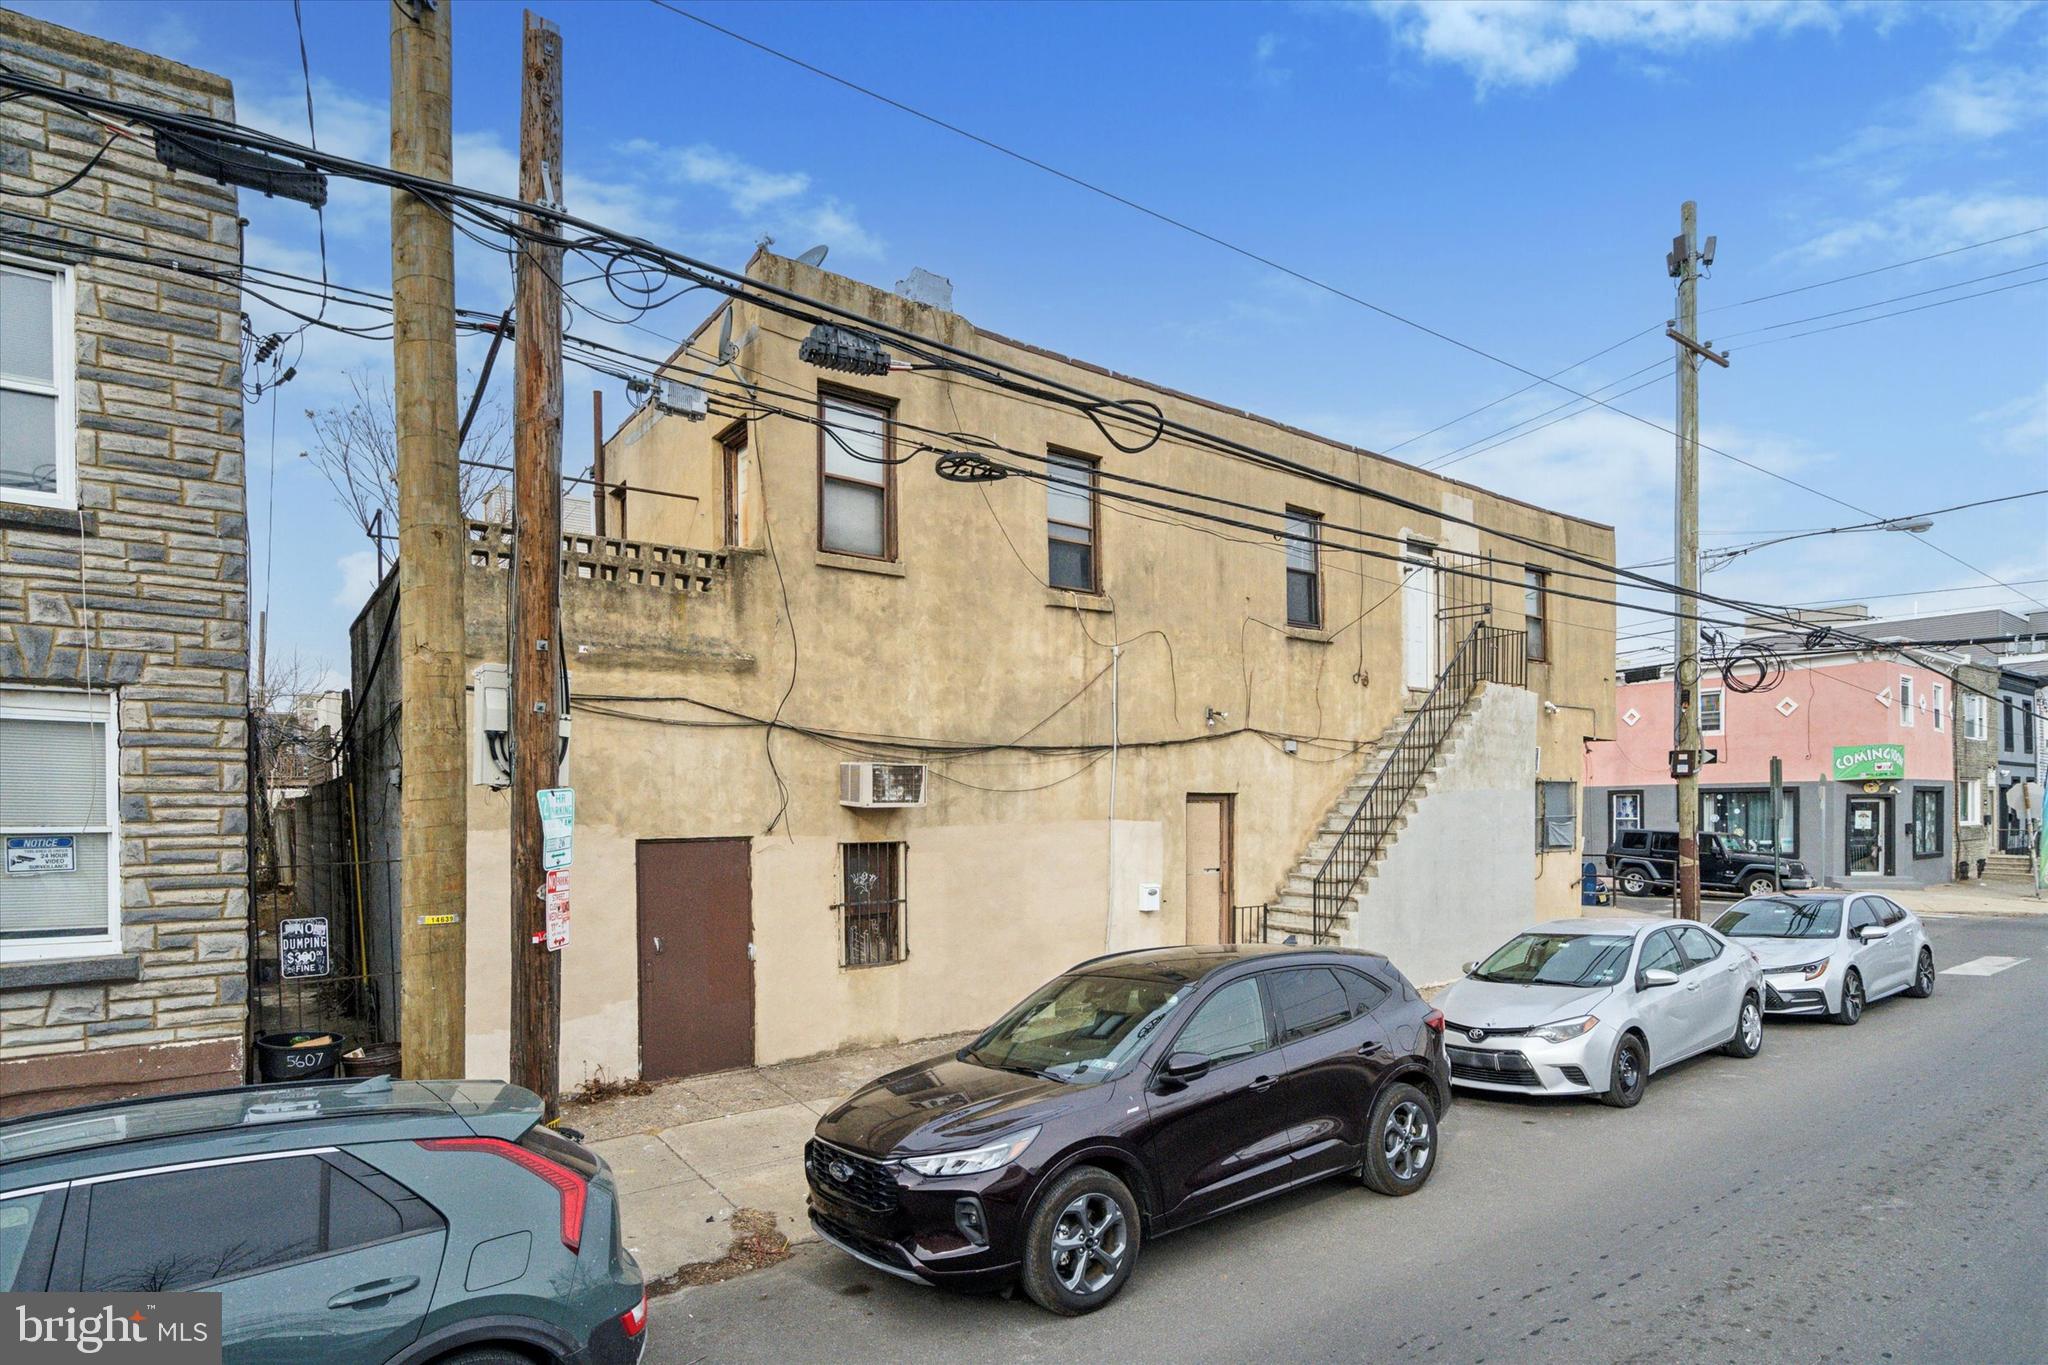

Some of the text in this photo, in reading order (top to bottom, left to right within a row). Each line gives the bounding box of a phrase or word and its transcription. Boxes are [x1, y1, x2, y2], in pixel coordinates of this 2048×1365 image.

[1836, 747, 1890, 769] COMING
[23, 838, 59, 848] NOTICE
[283, 937, 326, 950] DUMPING
[296, 964, 316, 972] FINE
[286, 1053, 324, 1068] 5607
